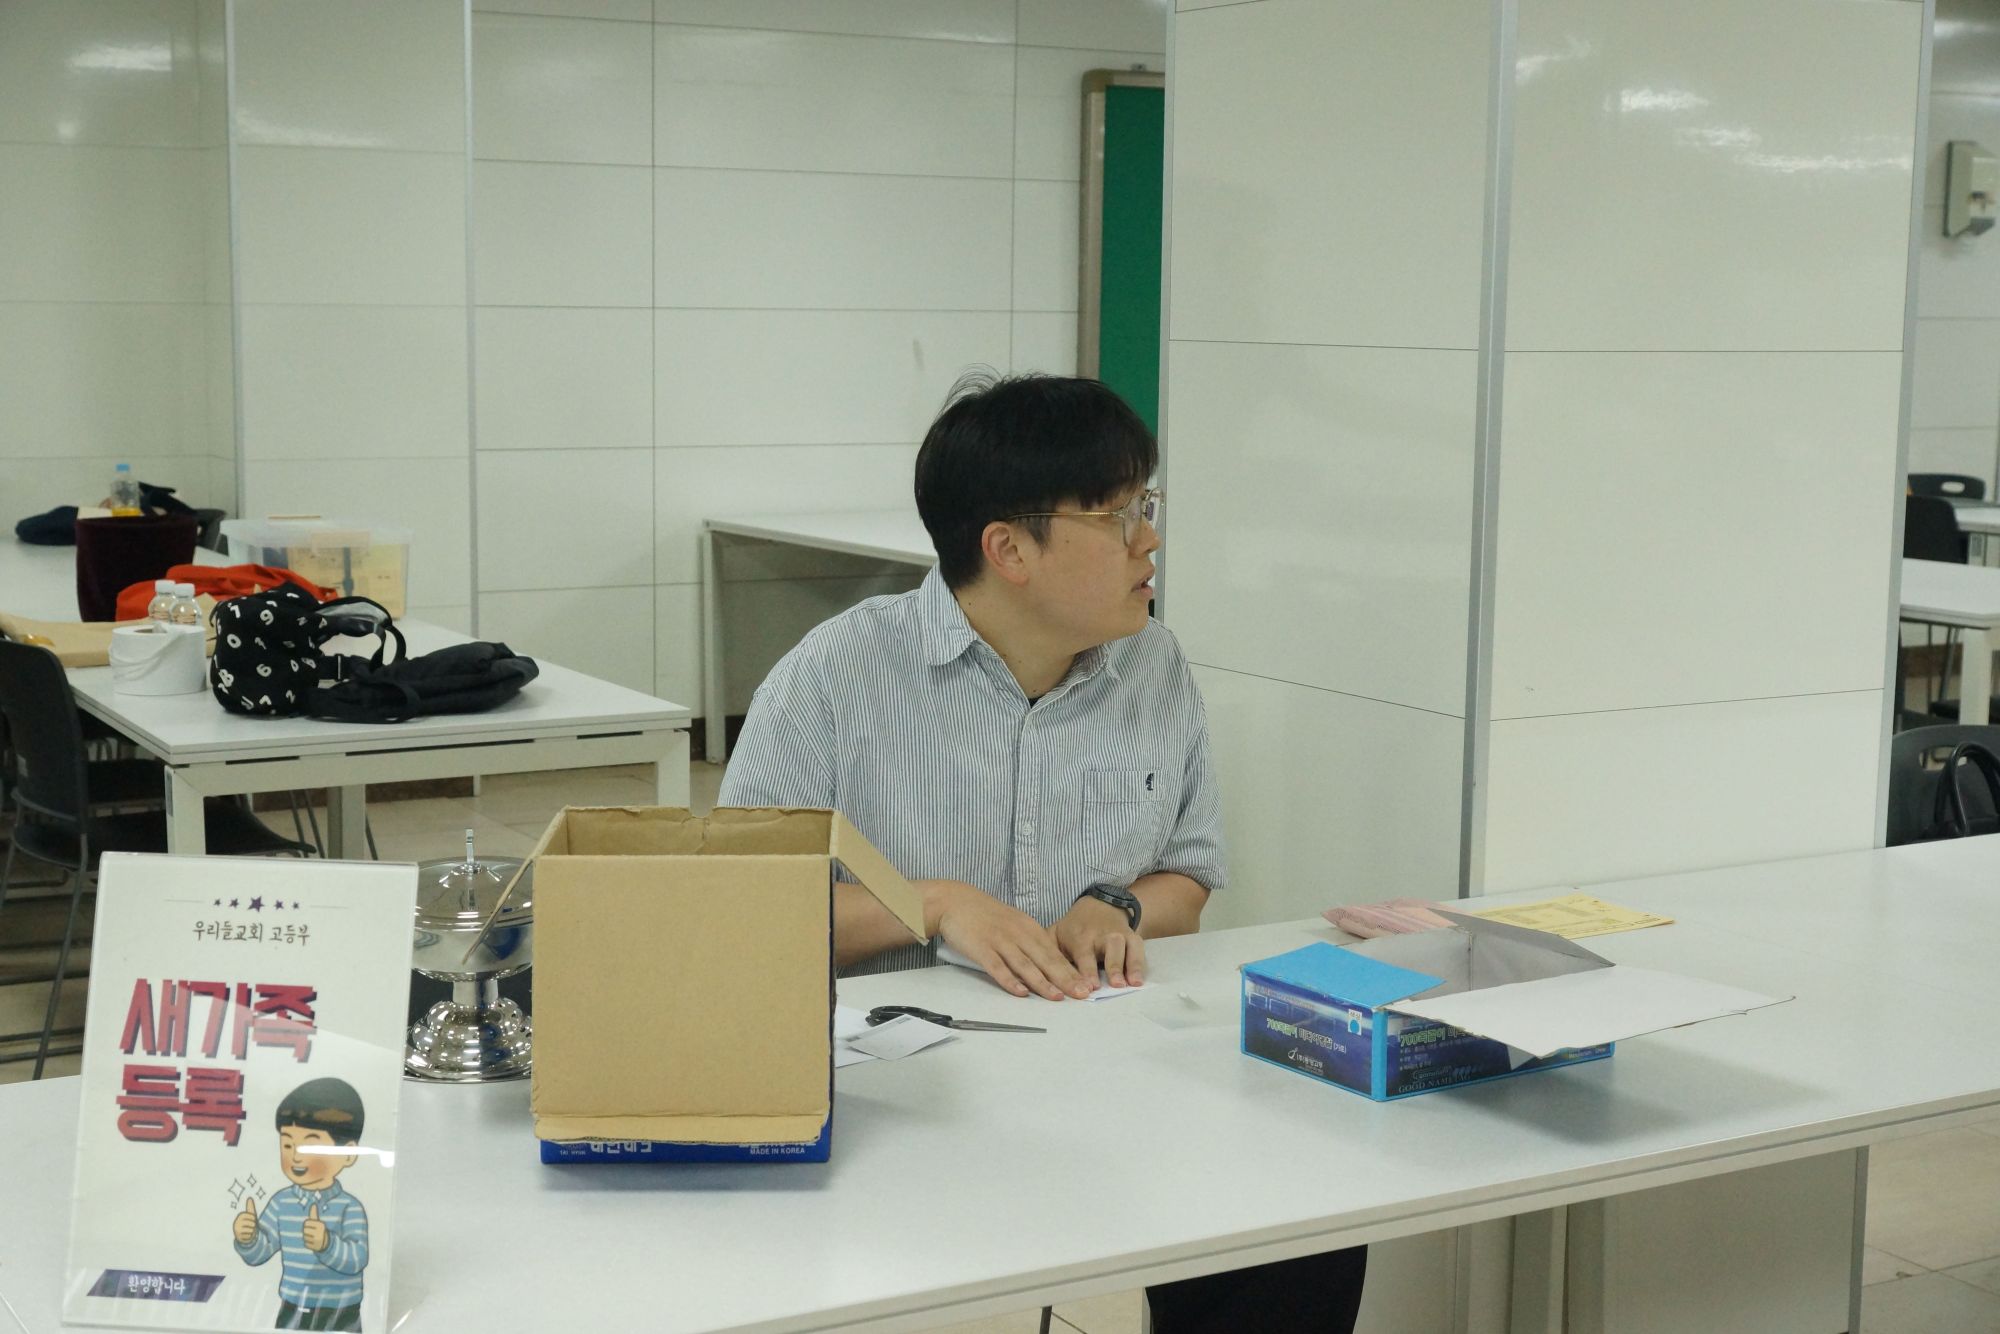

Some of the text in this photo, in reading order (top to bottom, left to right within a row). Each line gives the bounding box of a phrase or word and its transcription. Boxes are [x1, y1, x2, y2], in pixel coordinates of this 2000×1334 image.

[192, 920, 311, 946] 우리들교회 고등부
[119, 978, 317, 1063] 새가족
[1398, 1081, 1426, 1094] GOOD
[115, 1064, 247, 1147] 등록
[750, 1147, 805, 1155] MADE IN KOREA
[128, 1274, 186, 1296] 환영합니다
